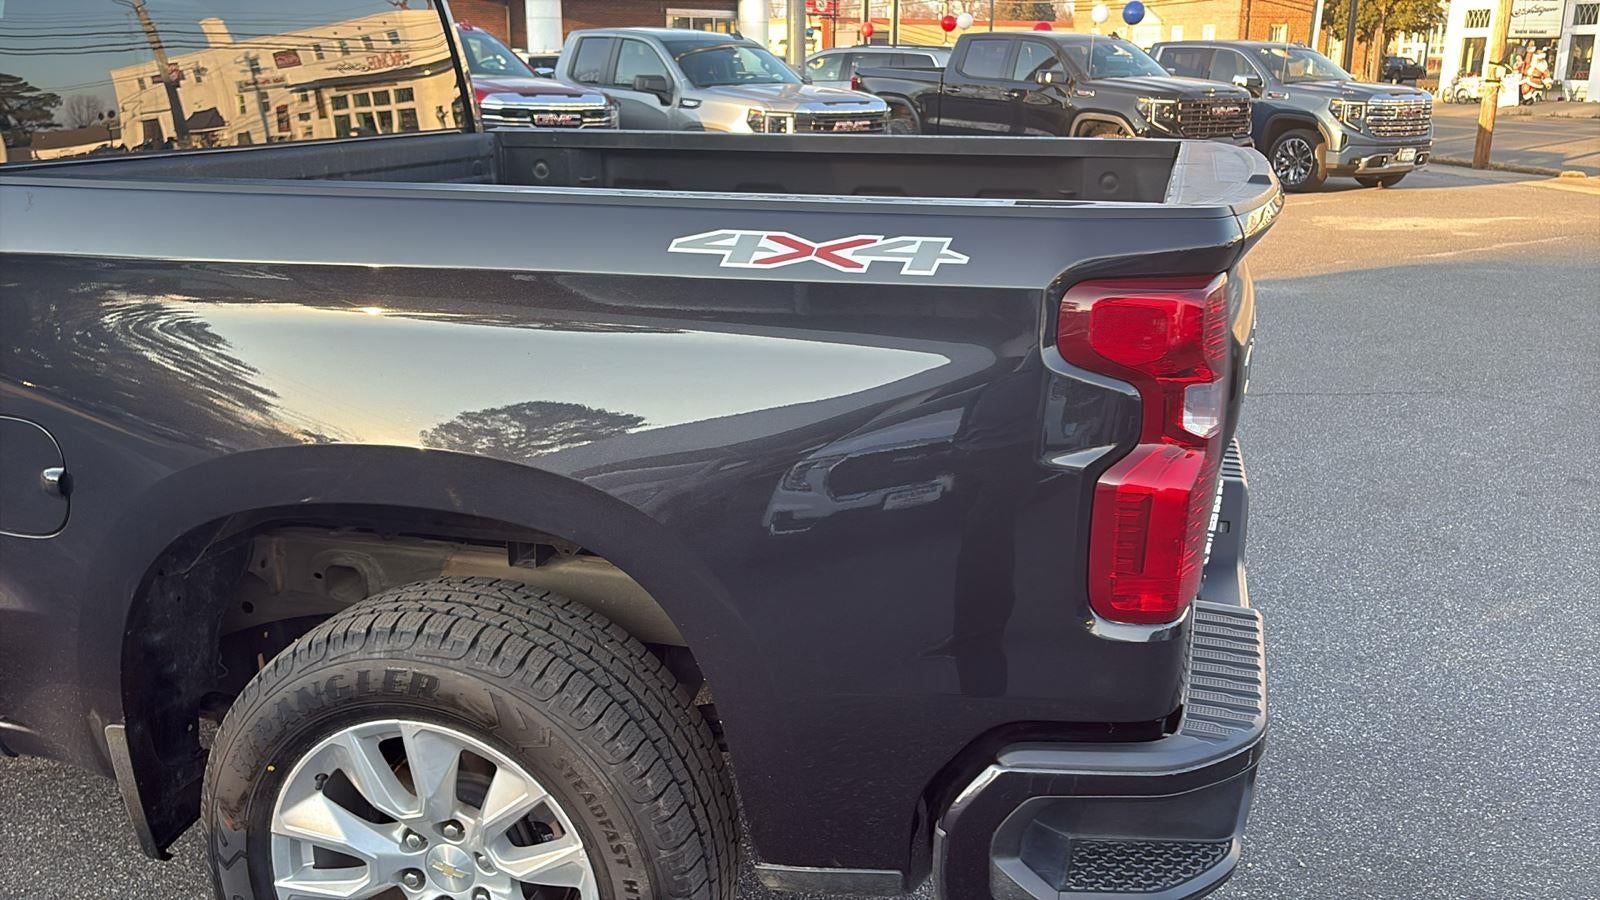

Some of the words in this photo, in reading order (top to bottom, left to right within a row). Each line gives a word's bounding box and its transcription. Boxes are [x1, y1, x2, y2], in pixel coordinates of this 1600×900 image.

[533, 113, 581, 126] GMC
[552, 759, 632, 868] STEADFAST
[622, 879, 641, 900] H
